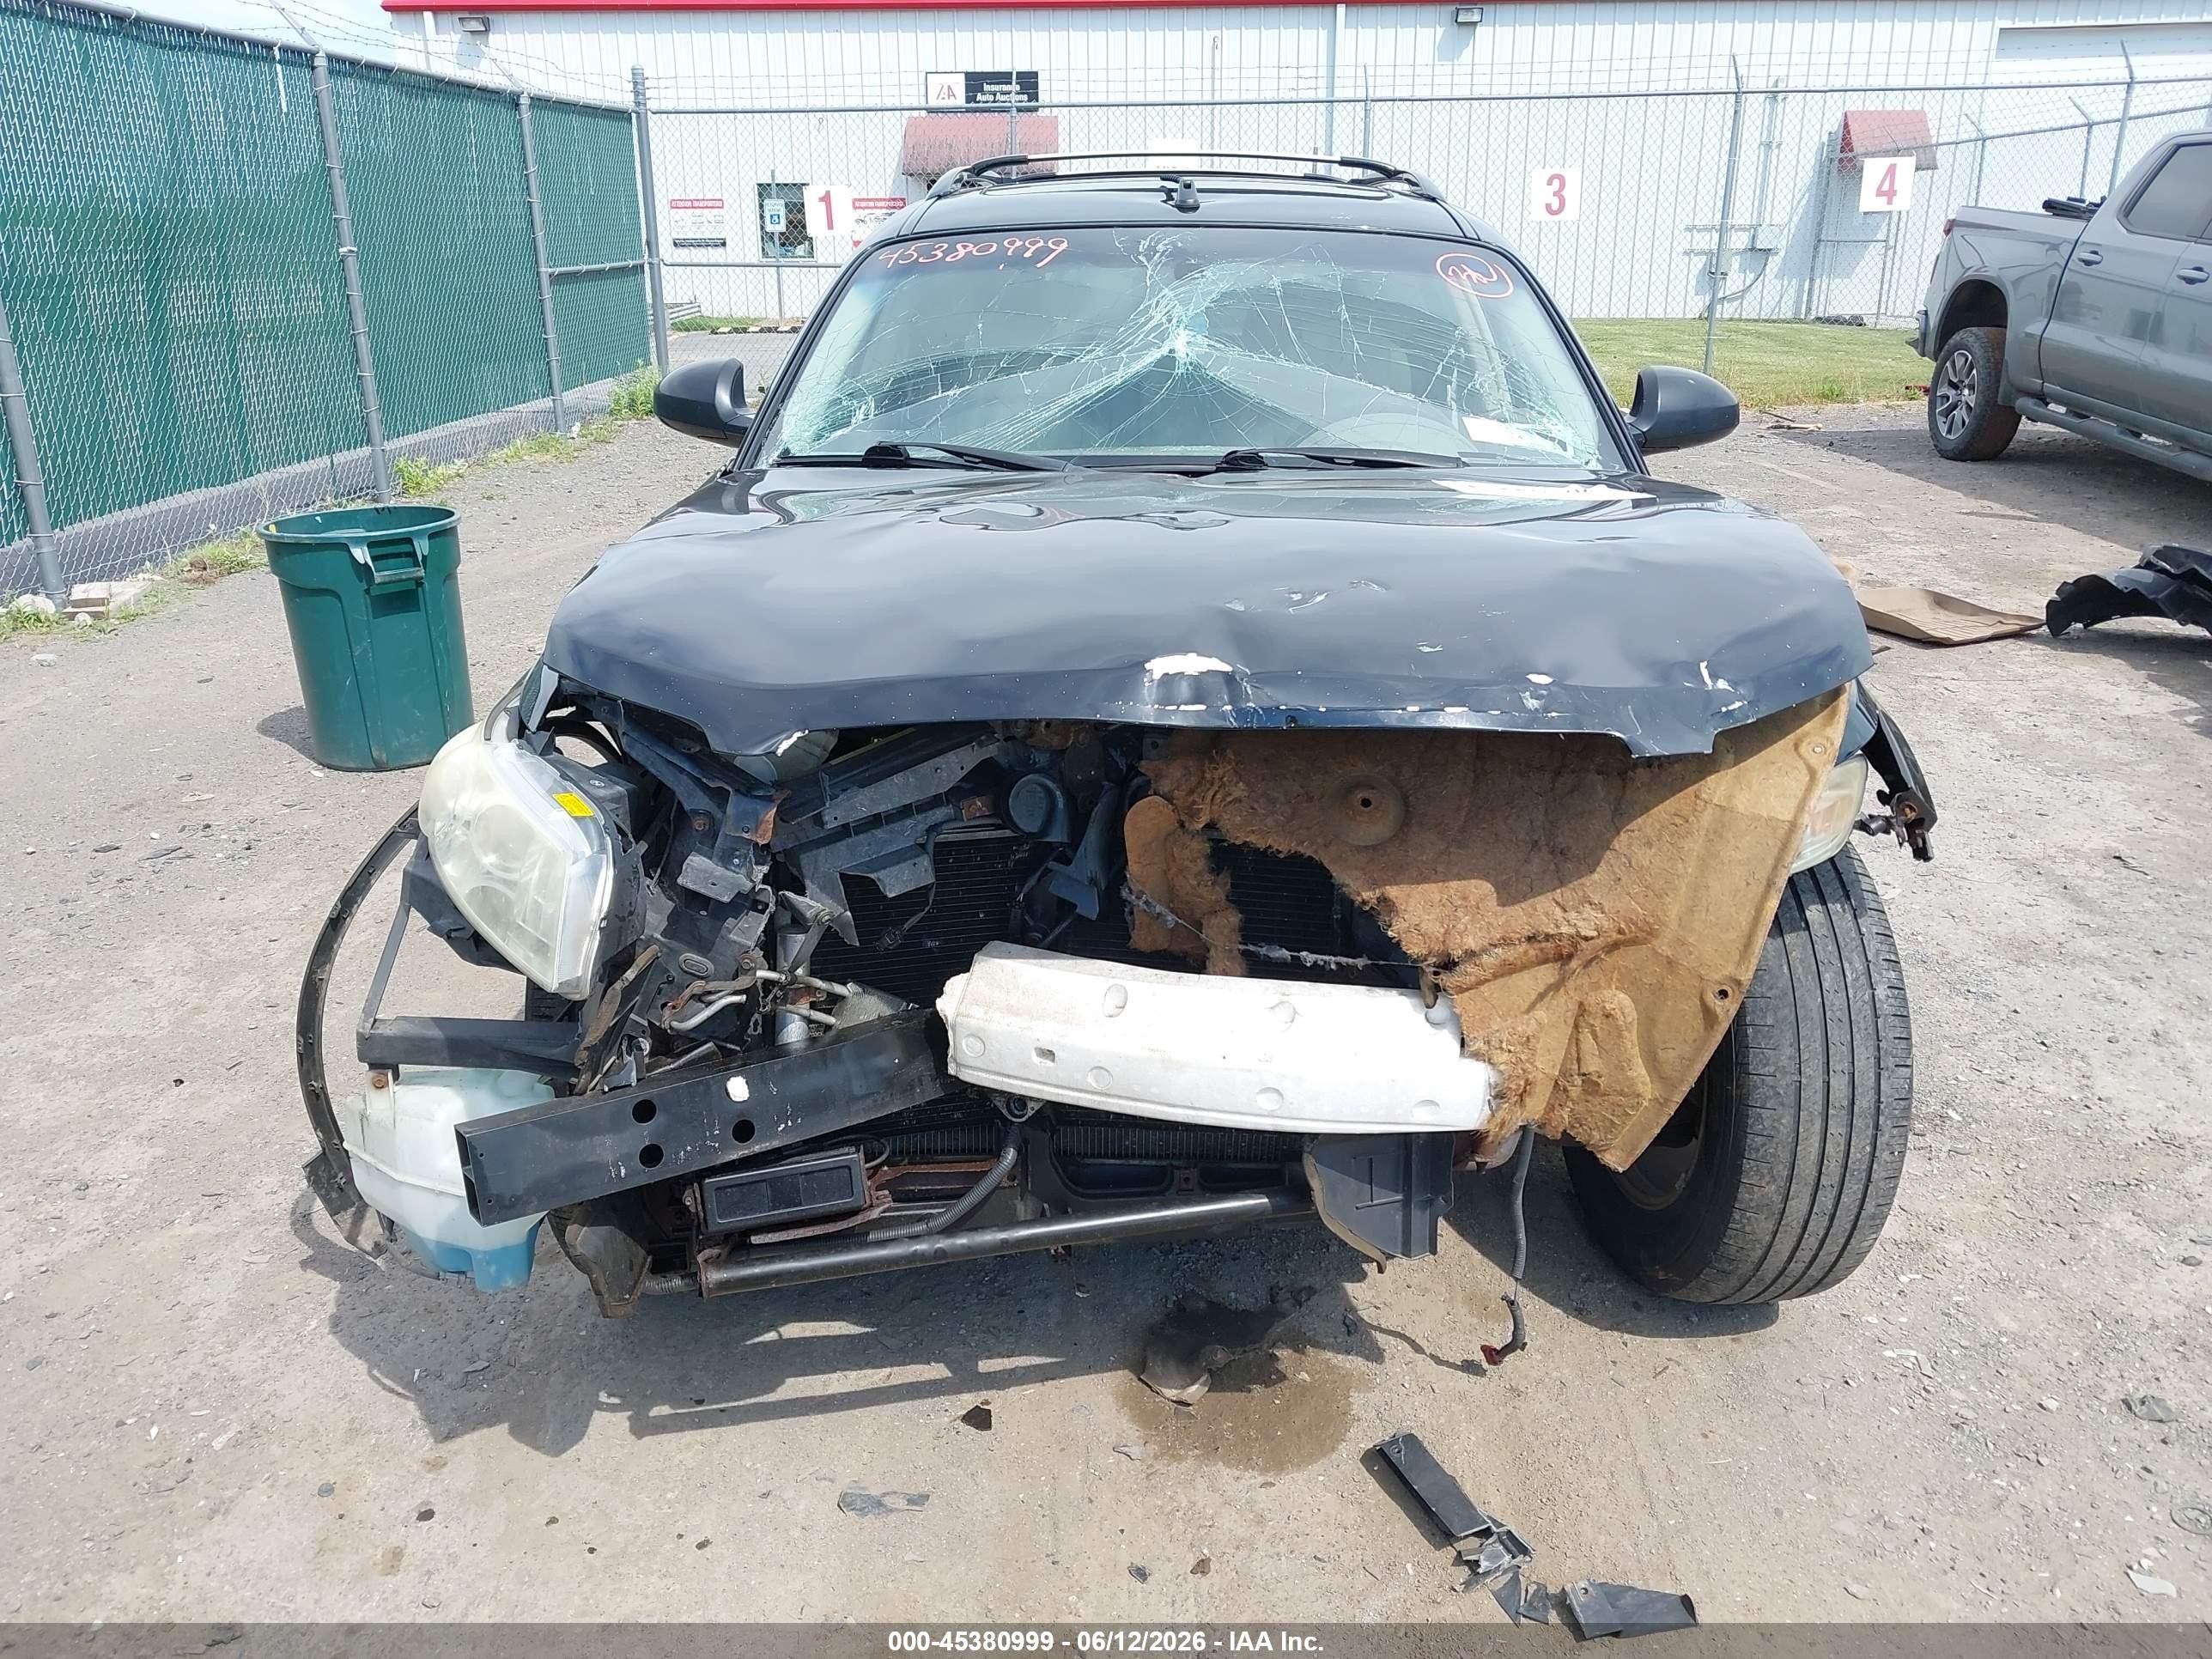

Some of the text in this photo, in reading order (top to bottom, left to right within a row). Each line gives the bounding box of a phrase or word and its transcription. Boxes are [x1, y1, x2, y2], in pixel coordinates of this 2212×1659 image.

[976, 92, 1029, 101] Auto Auctons
[983, 82, 1021, 92] Insurane
[1545, 173, 1566, 216] 3
[1875, 163, 1898, 205] 4
[817, 190, 835, 230] 1
[878, 237, 1070, 268] 45380999
